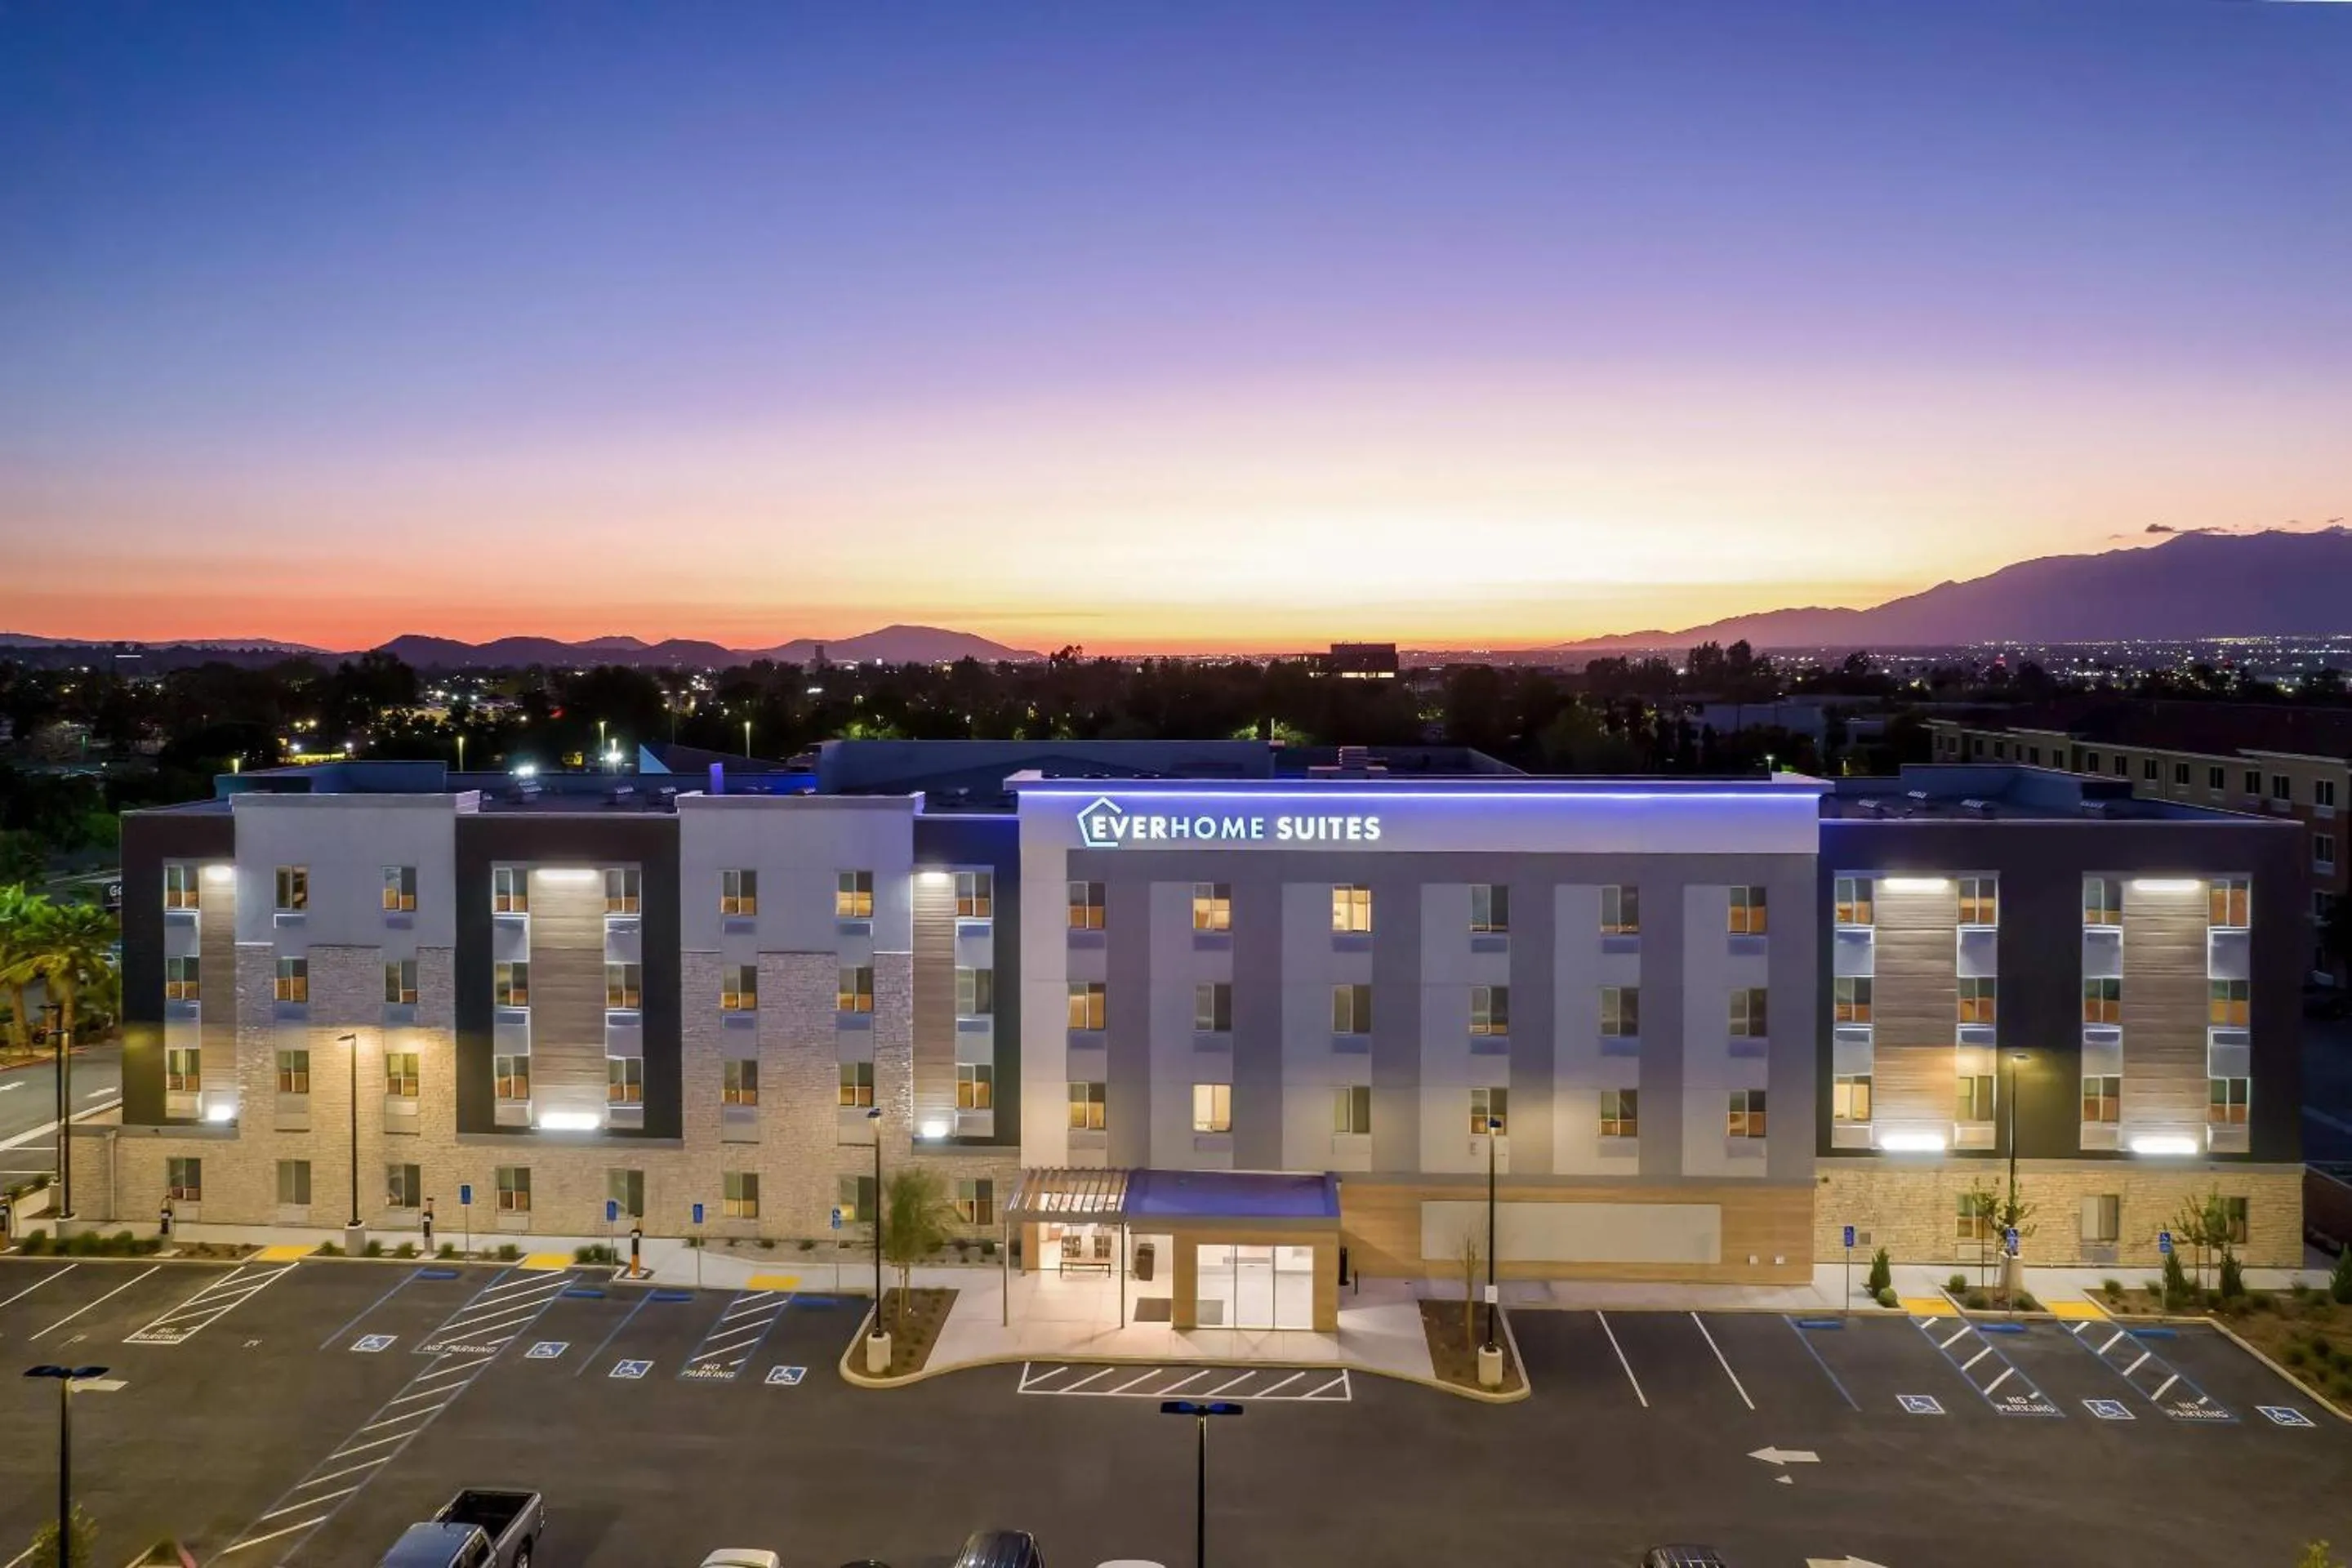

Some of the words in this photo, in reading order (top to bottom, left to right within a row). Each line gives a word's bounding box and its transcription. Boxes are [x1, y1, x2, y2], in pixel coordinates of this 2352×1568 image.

[1092, 817, 1265, 840] EVERHOME
[1276, 817, 1381, 840] SUITES
[680, 1370, 736, 1379] PARKING
[2006, 1396, 2028, 1405] NO
[1993, 1404, 2056, 1414] PARKING
